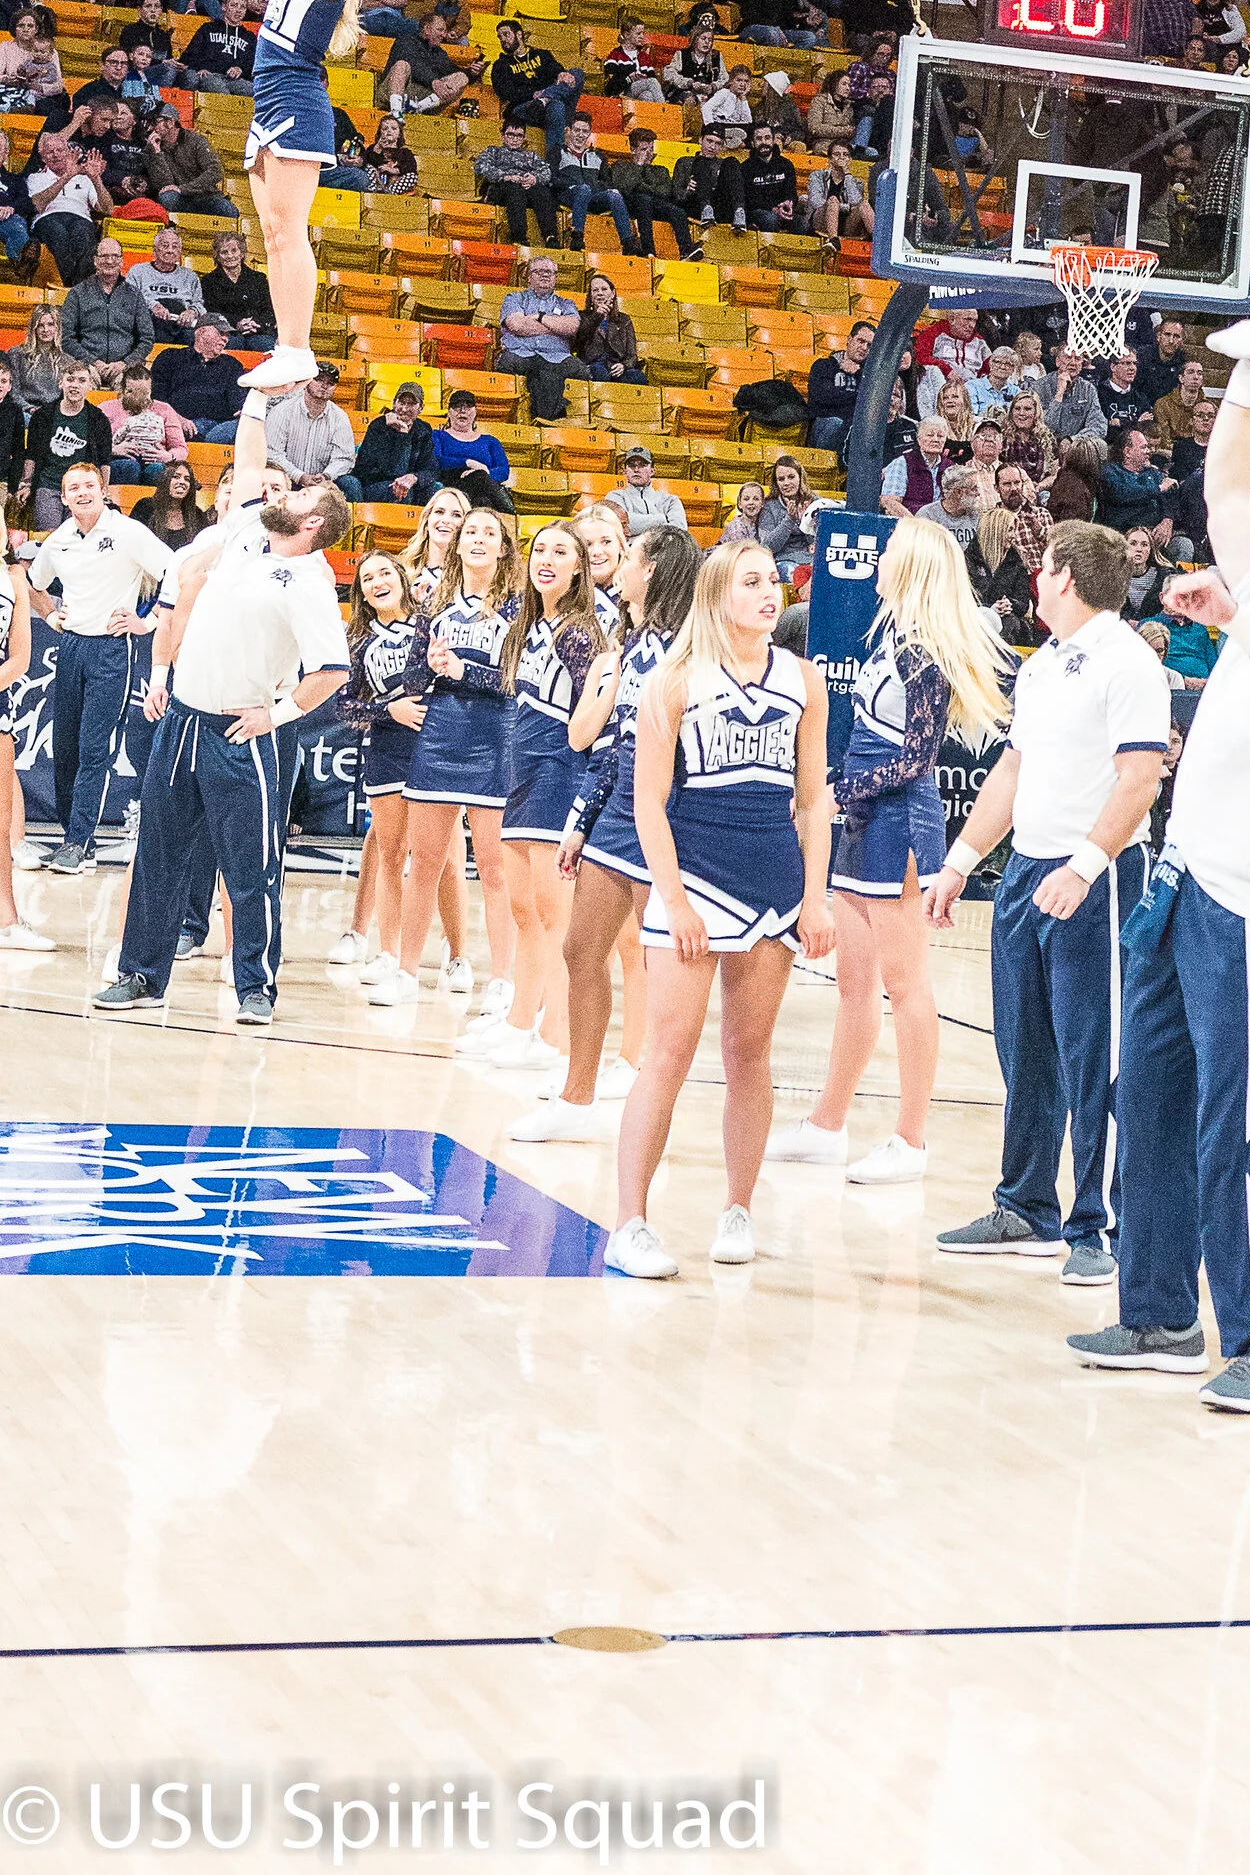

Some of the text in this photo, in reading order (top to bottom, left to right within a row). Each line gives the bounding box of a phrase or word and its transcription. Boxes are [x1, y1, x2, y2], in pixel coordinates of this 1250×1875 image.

[209, 31, 229, 44] UTAH
[904, 254, 940, 267] SPALDING
[150, 285, 179, 295] USU
[825, 546, 879, 564] STATE
[707, 715, 793, 767] AGGIES
